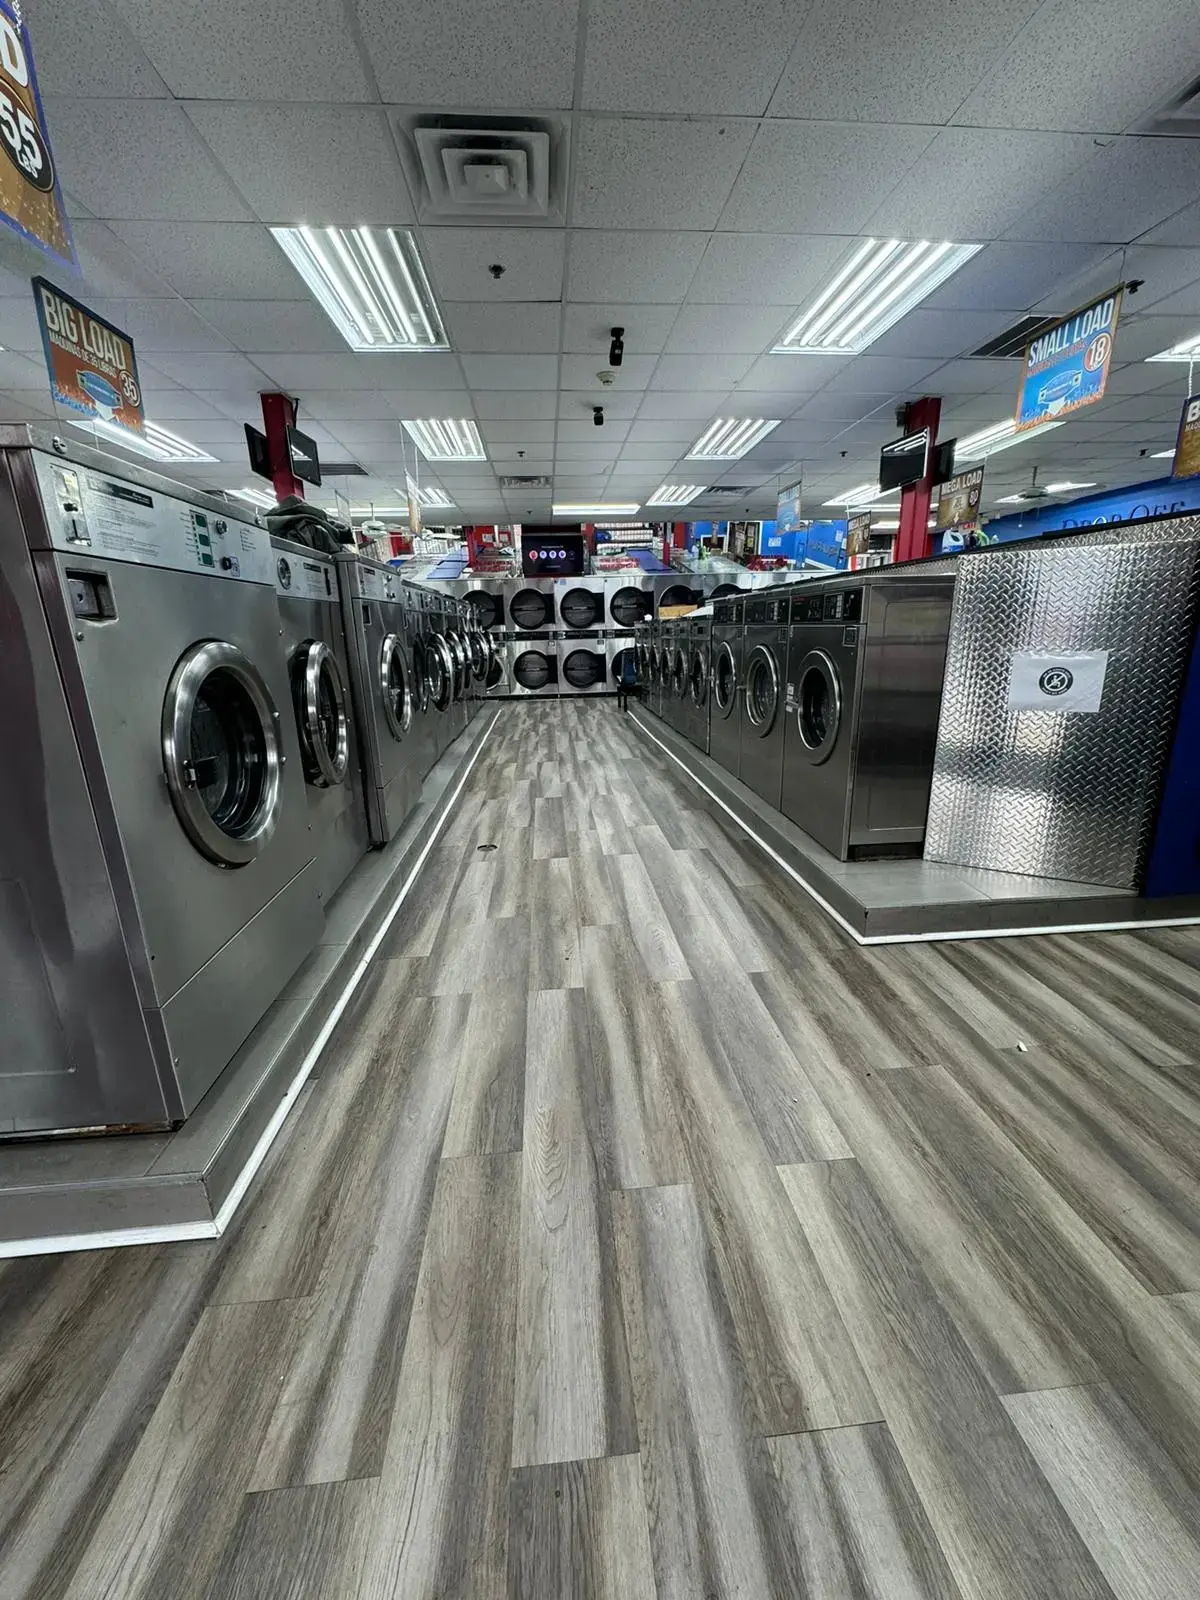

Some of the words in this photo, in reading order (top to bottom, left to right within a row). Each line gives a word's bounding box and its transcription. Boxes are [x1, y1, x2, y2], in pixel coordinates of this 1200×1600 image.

[41, 287, 79, 343] BIG
[79, 311, 126, 370] LOAD
[1028, 322, 1070, 367] SMALL
[1073, 298, 1114, 343] LOAD
[1089, 337, 1107, 368] 18
[121, 373, 138, 401] 35
[962, 470, 982, 489] LOAD
